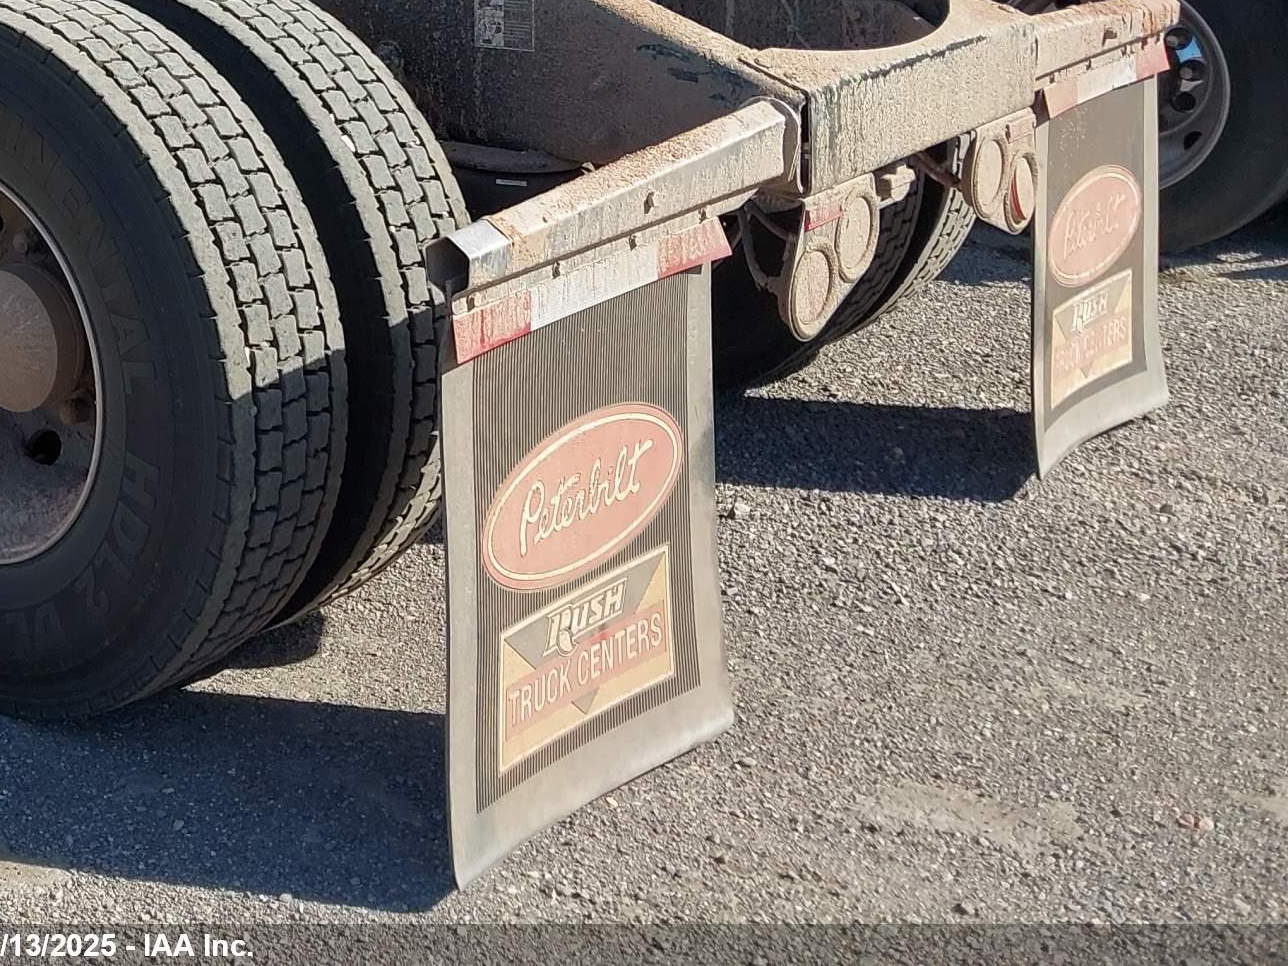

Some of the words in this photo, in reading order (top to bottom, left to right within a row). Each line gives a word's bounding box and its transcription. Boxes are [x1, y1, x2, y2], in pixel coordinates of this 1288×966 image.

[519, 438, 653, 556] Peterbilt
[508, 664, 570, 726] TRUCK
[577, 612, 663, 680] CENTERS
[543, 577, 628, 657] RUSH
